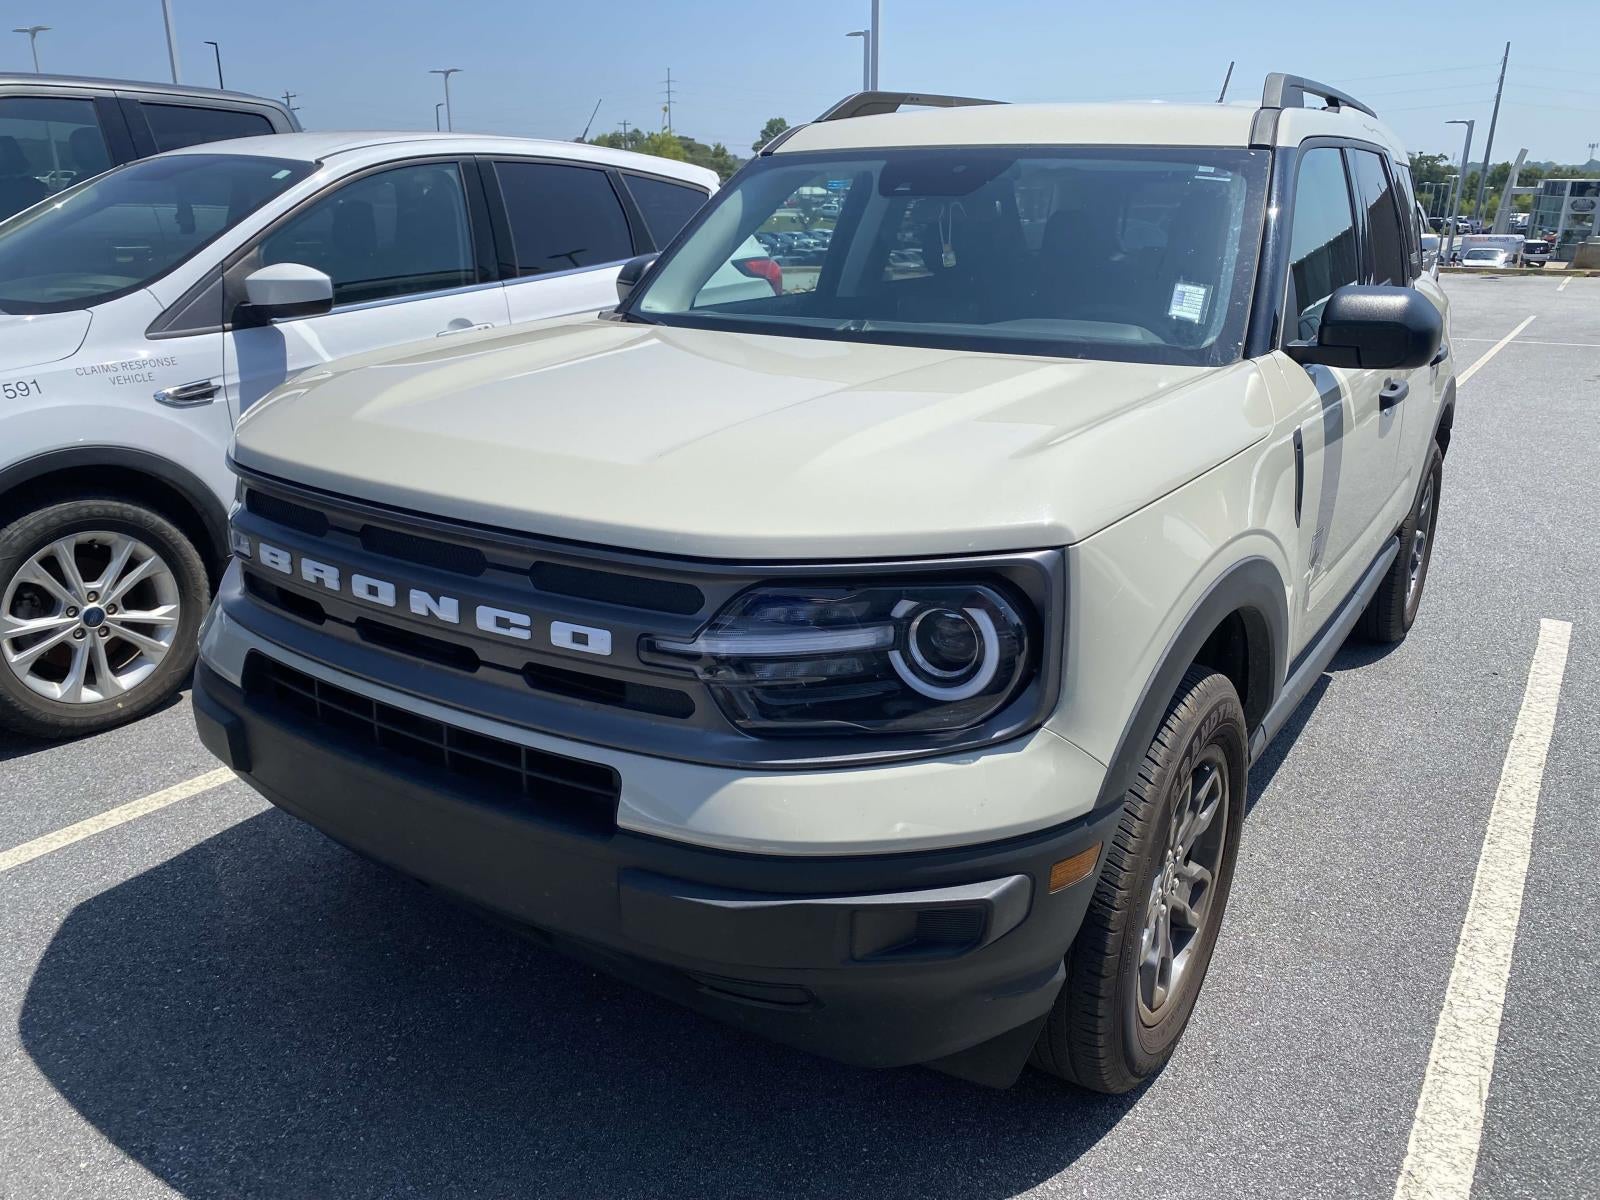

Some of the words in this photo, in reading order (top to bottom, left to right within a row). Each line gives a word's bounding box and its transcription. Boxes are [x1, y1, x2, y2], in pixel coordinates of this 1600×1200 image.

[75, 361, 119, 377] CLAIMS
[121, 356, 178, 372] RESPONSE
[2, 378, 43, 400] 591
[108, 372, 156, 386] VEHICLE
[258, 541, 612, 657] BRONCO
